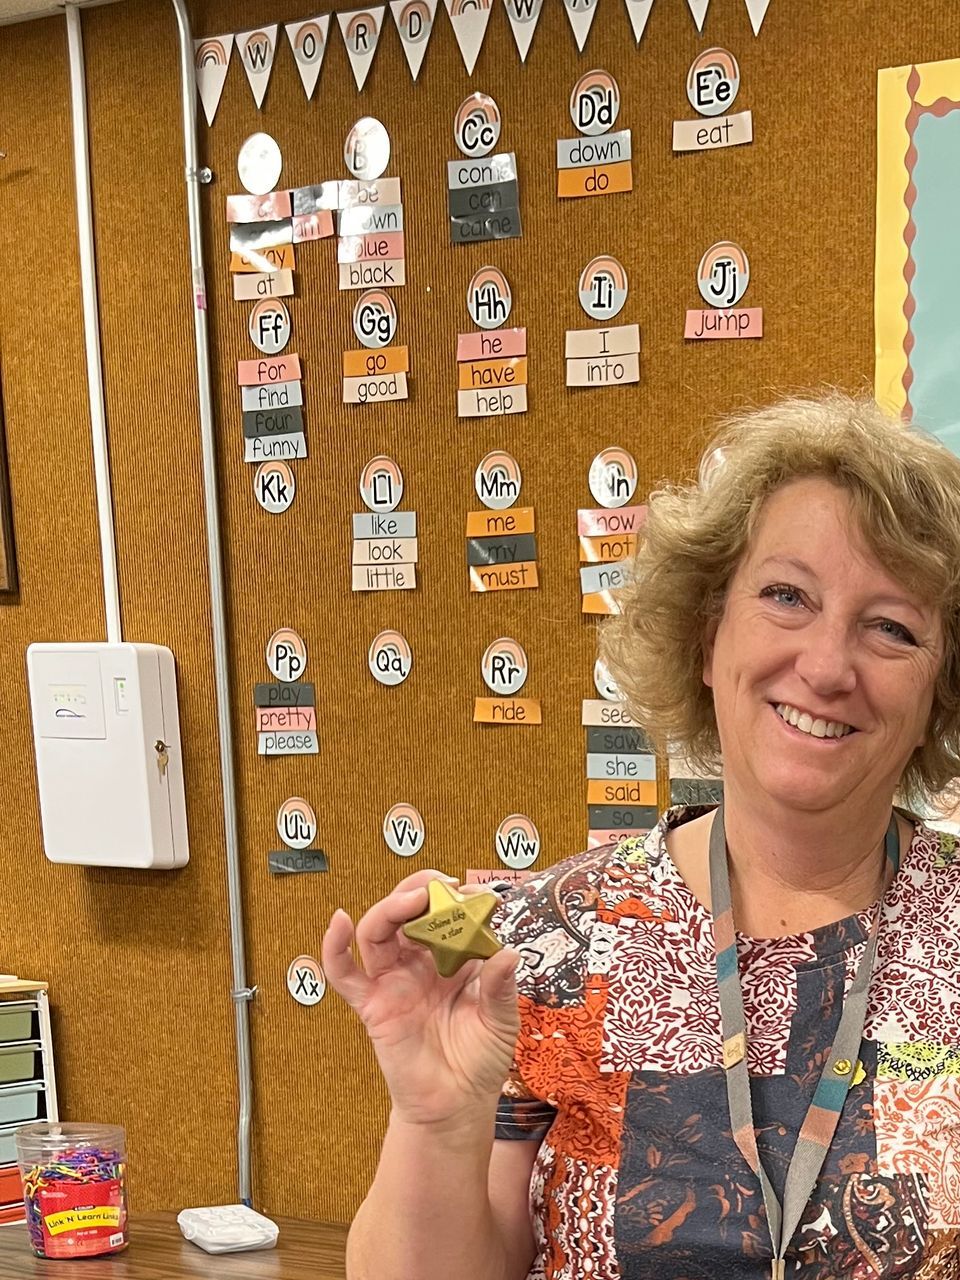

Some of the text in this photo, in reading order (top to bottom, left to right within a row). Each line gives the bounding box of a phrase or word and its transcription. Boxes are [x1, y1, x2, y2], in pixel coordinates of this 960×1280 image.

[696, 69, 731, 106] Ee
[579, 89, 612, 127] Dd
[461, 119, 495, 150] Cc
[696, 118, 734, 145] eat
[570, 139, 621, 163] down
[458, 165, 512, 185] com
[585, 168, 609, 191] do
[257, 273, 275, 295] at
[350, 262, 395, 285] black
[710, 261, 737, 304] Jj
[475, 287, 506, 321] Hh
[592, 276, 613, 309] Ii
[259, 313, 284, 345] Ff
[359, 305, 391, 342] Gg
[695, 311, 750, 337] jump
[481, 334, 503, 355] he
[600, 330, 610, 353] I
[257, 361, 287, 382] for
[366, 354, 387, 375] go
[472, 365, 516, 386] have
[587, 359, 625, 381] into
[259, 385, 289, 408] find
[358, 375, 398, 403] good
[477, 392, 514, 414] help
[255, 413, 292, 433] four
[252, 438, 300, 458] funny
[261, 474, 288, 503] Kk
[373, 474, 393, 505] Ll
[480, 472, 517, 498] Mm
[371, 514, 398, 535] like
[487, 515, 516, 532] me
[597, 513, 635, 532] now
[368, 540, 403, 560] look
[601, 536, 634, 557] not
[367, 567, 405, 588] little
[480, 565, 528, 586] must
[275, 644, 301, 679] Pp
[376, 648, 406, 678] Qq
[491, 655, 521, 685] Rr
[268, 683, 301, 705] play
[260, 706, 312, 731] pretty
[491, 703, 525, 720] ride
[600, 705, 631, 724] see
[265, 731, 313, 755] please
[603, 731, 640, 749] saw
[605, 756, 638, 776] she
[604, 783, 640, 802] said
[283, 813, 311, 840] Uu
[612, 810, 634, 826] so
[391, 819, 418, 847] Vv
[498, 833, 536, 858] Ww
[275, 852, 322, 871] under
[295, 969, 320, 997] Xx
[48, 1219, 64, 1229] Link
[77, 1213, 100, 1221] Learn
